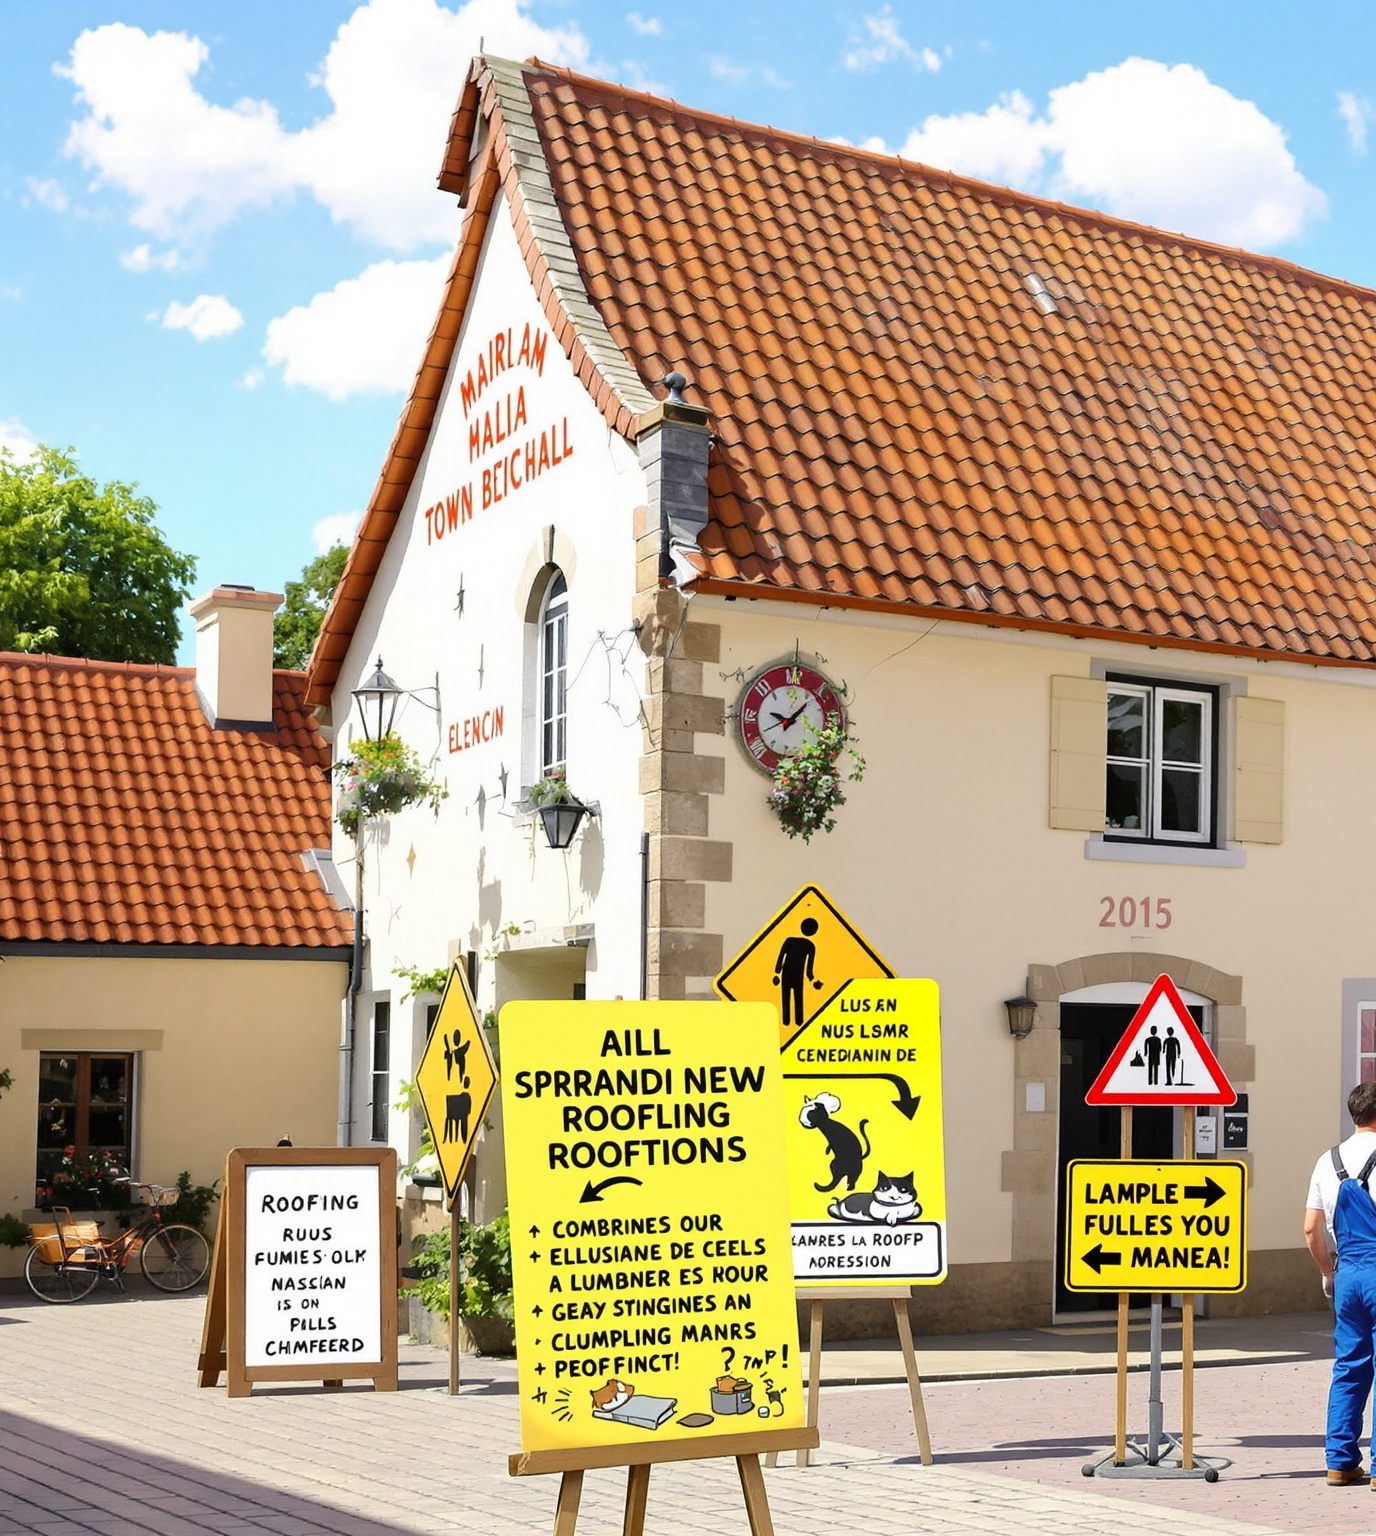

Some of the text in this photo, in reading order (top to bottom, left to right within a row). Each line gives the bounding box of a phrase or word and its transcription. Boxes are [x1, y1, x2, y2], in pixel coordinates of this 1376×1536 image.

[425, 482, 472, 545] TOWN
[1099, 896, 1172, 929] 2015
[841, 999, 870, 1012] LUS
[601, 1029, 671, 1057] AILL
[822, 1025, 853, 1038] NUS
[897, 1049, 916, 1061] DE
[515, 1066, 764, 1098] SPRRANDI NEW
[563, 1102, 729, 1132] ROOFLING
[549, 1136, 746, 1169] ROOFTIONS
[262, 1195, 358, 1213] ROOFING
[1086, 1183, 1178, 1204] LAMPLE
[284, 1227, 331, 1241] RUUS
[553, 1214, 722, 1238] COMBRINES OUR
[1085, 1215, 1229, 1236] FULLES YOU
[551, 1238, 765, 1265] ELLUSIANE DE CEELS
[853, 1237, 866, 1245] LA
[874, 1233, 922, 1246] ROOFP
[1131, 1247, 1229, 1268] MANEA!
[550, 1276, 562, 1292] A
[571, 1270, 670, 1291] LUMBNER
[680, 1267, 703, 1285] ES
[278, 1299, 319, 1310] IS ON
[552, 1294, 750, 1321] GEAY STINGINES AN
[552, 1322, 756, 1351] CLUMPLING MANRS
